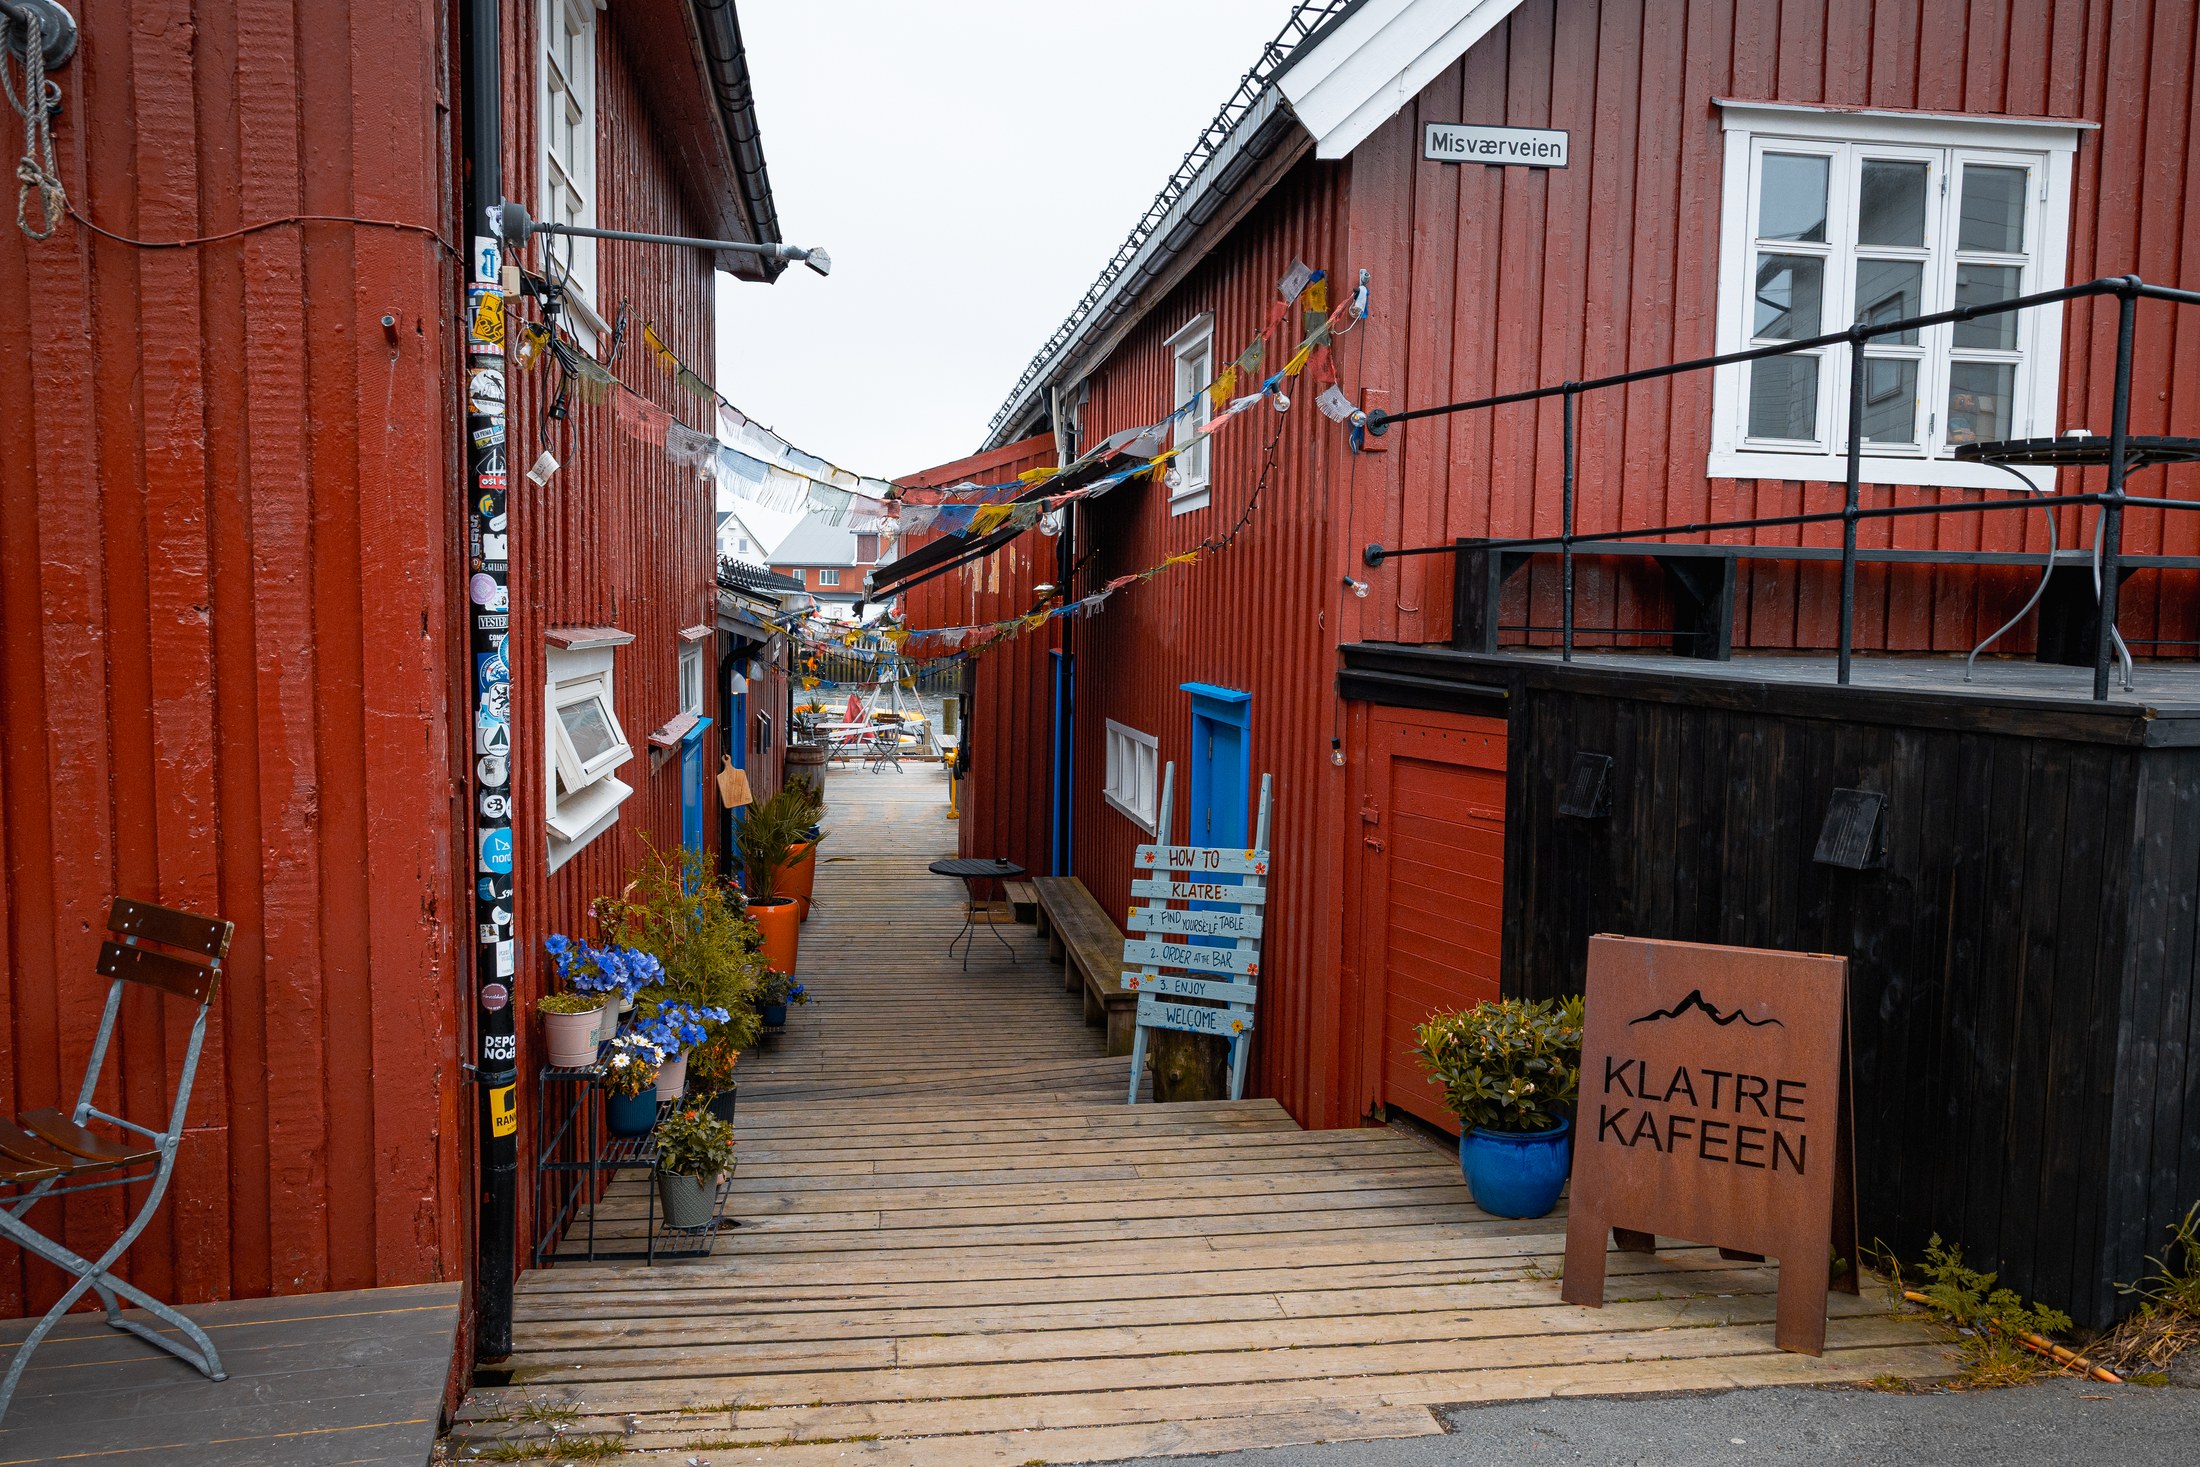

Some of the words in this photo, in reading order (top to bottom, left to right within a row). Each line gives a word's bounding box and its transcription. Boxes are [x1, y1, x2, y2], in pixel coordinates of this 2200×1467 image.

[1432, 132, 1561, 158] Misværveien
[1169, 849, 1196, 867] HOW
[1202, 850, 1220, 868] TO
[1172, 883, 1227, 900] KLATRE:
[1161, 911, 1181, 925] FIND
[1219, 915, 1245, 931] TABLE
[1150, 948, 1159, 959] 2.
[1163, 945, 1192, 965] ORDER
[1212, 951, 1233, 968] BAR
[1160, 980, 1168, 991] 3.
[1175, 980, 1206, 995] ENJOY
[1166, 1008, 1217, 1029] WELCOME
[1604, 1056, 1807, 1122] KLATRE
[1598, 1105, 1807, 1175] KAFEEN
